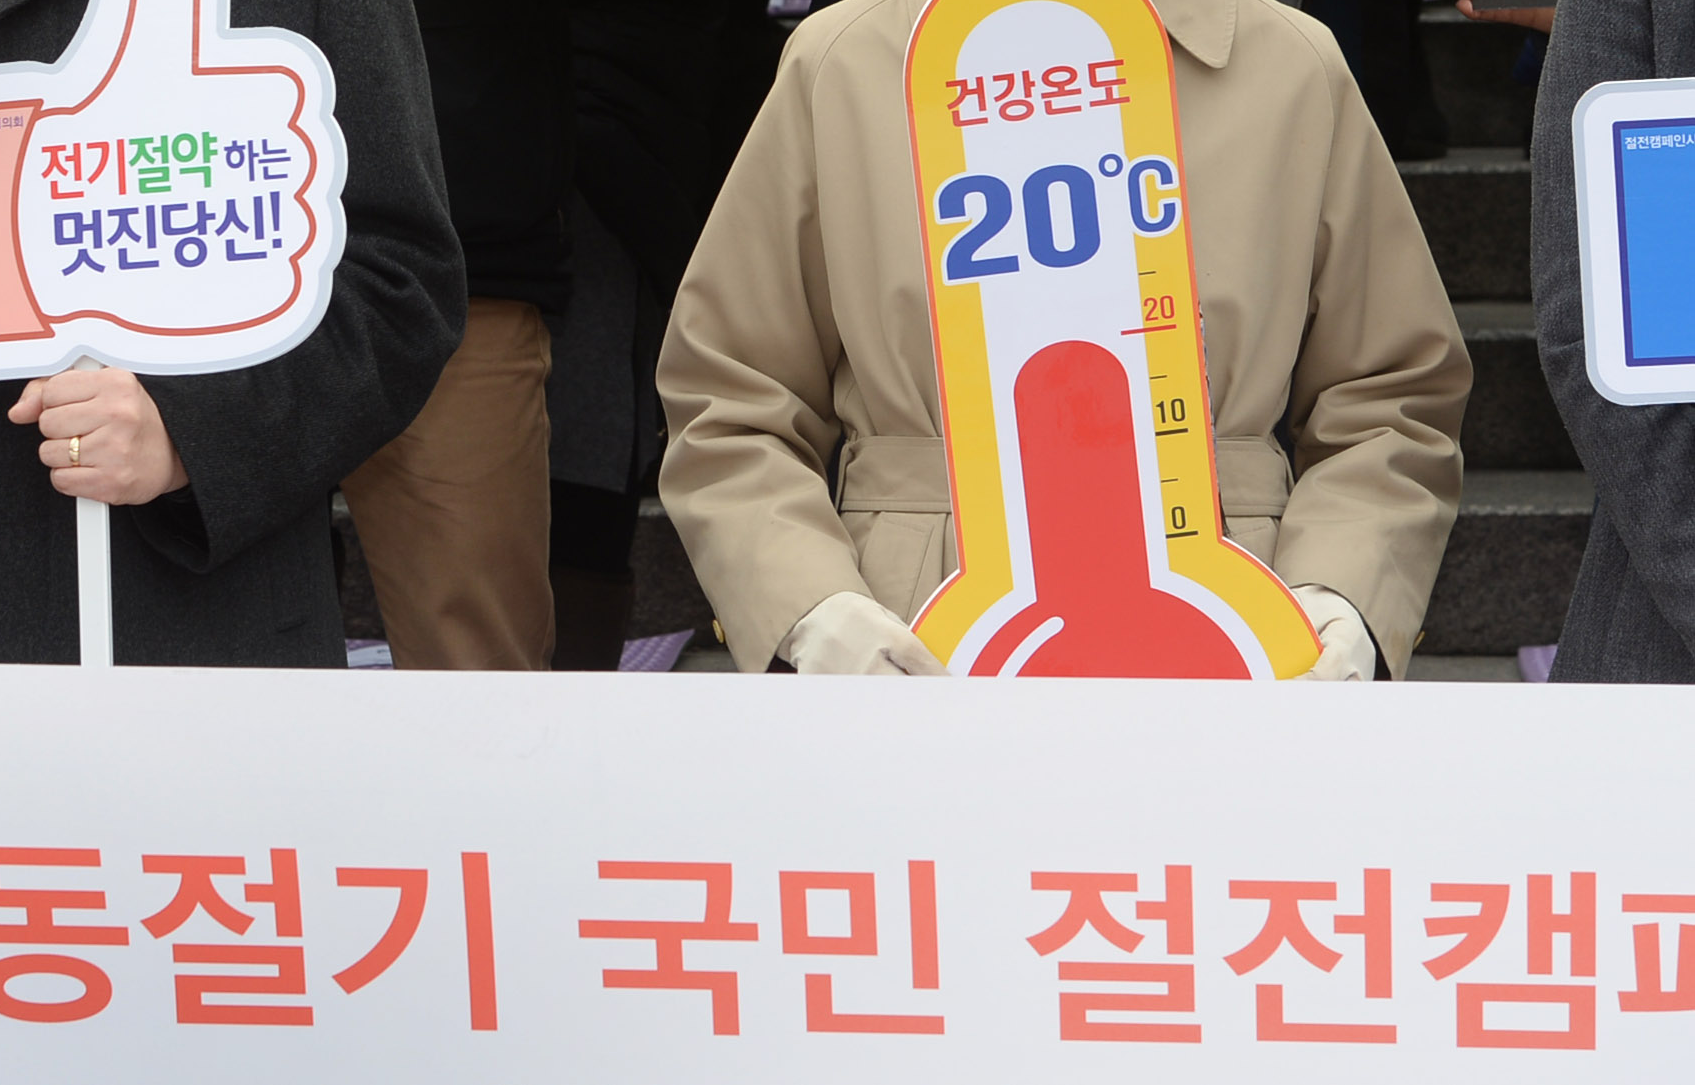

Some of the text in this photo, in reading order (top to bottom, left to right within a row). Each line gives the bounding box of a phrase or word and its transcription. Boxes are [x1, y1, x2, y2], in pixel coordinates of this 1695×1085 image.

[946, 59, 1131, 127] 건강온도
[41, 131, 292, 200] 전기절약 하는
[52, 191, 283, 276] 멋진당신!
[1142, 295, 1176, 321] 20
[1156, 398, 1186, 424] 10
[1171, 506, 1187, 530] 0
[578, 859, 946, 1036] 국민
